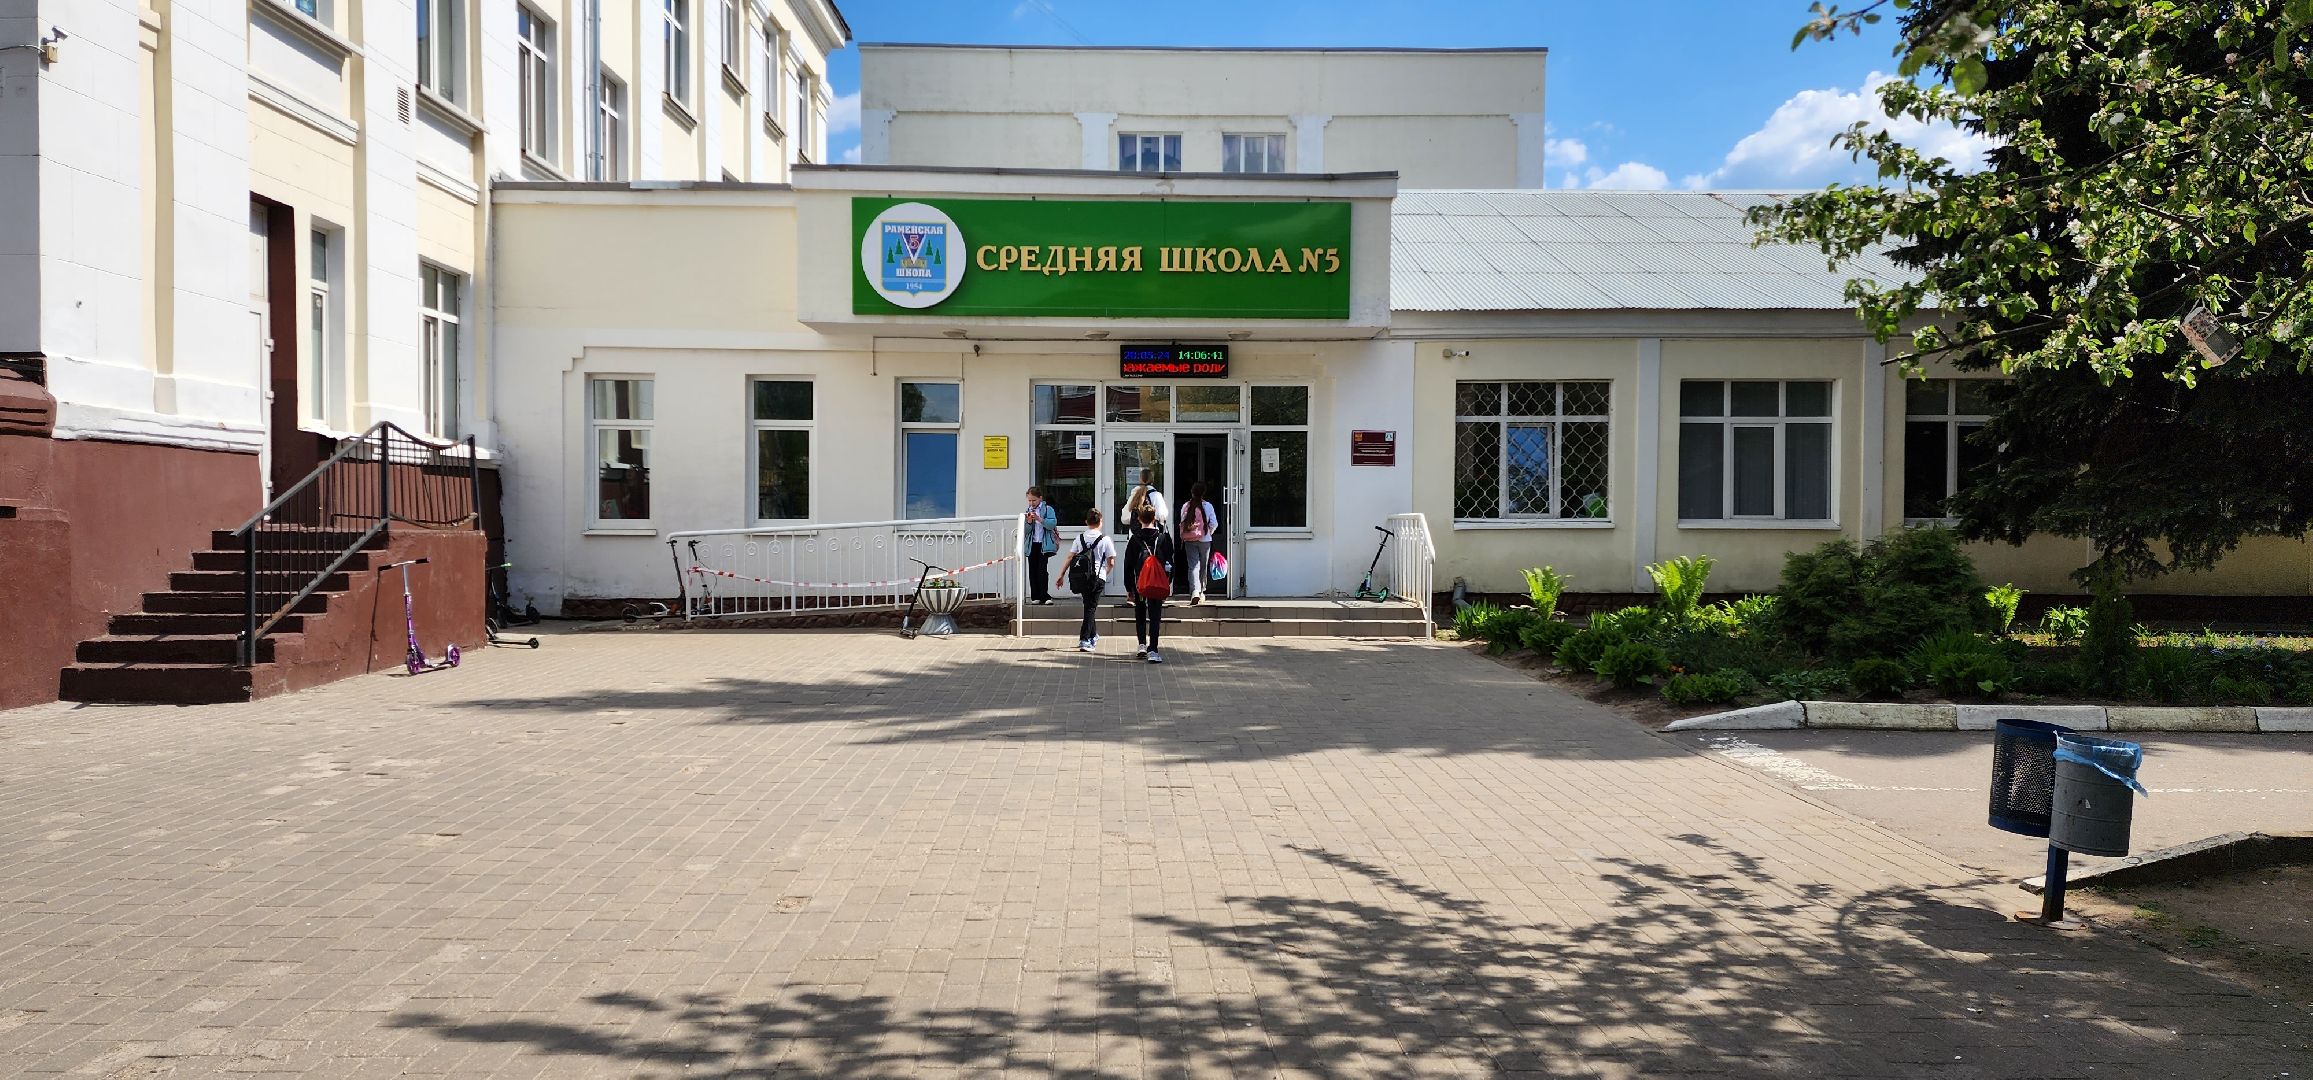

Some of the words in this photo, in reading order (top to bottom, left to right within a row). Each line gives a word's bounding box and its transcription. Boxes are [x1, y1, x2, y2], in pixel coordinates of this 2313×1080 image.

[885, 225, 943, 234] РАМЕНСКАЯ
[909, 235, 920, 249] 5
[976, 245, 1142, 275] СРЕДНЯЯ
[1159, 247, 1293, 273] ШКОЛА
[896, 268, 932, 277] ШКОЛА
[1178, 351, 1224, 360] 14:06:41
